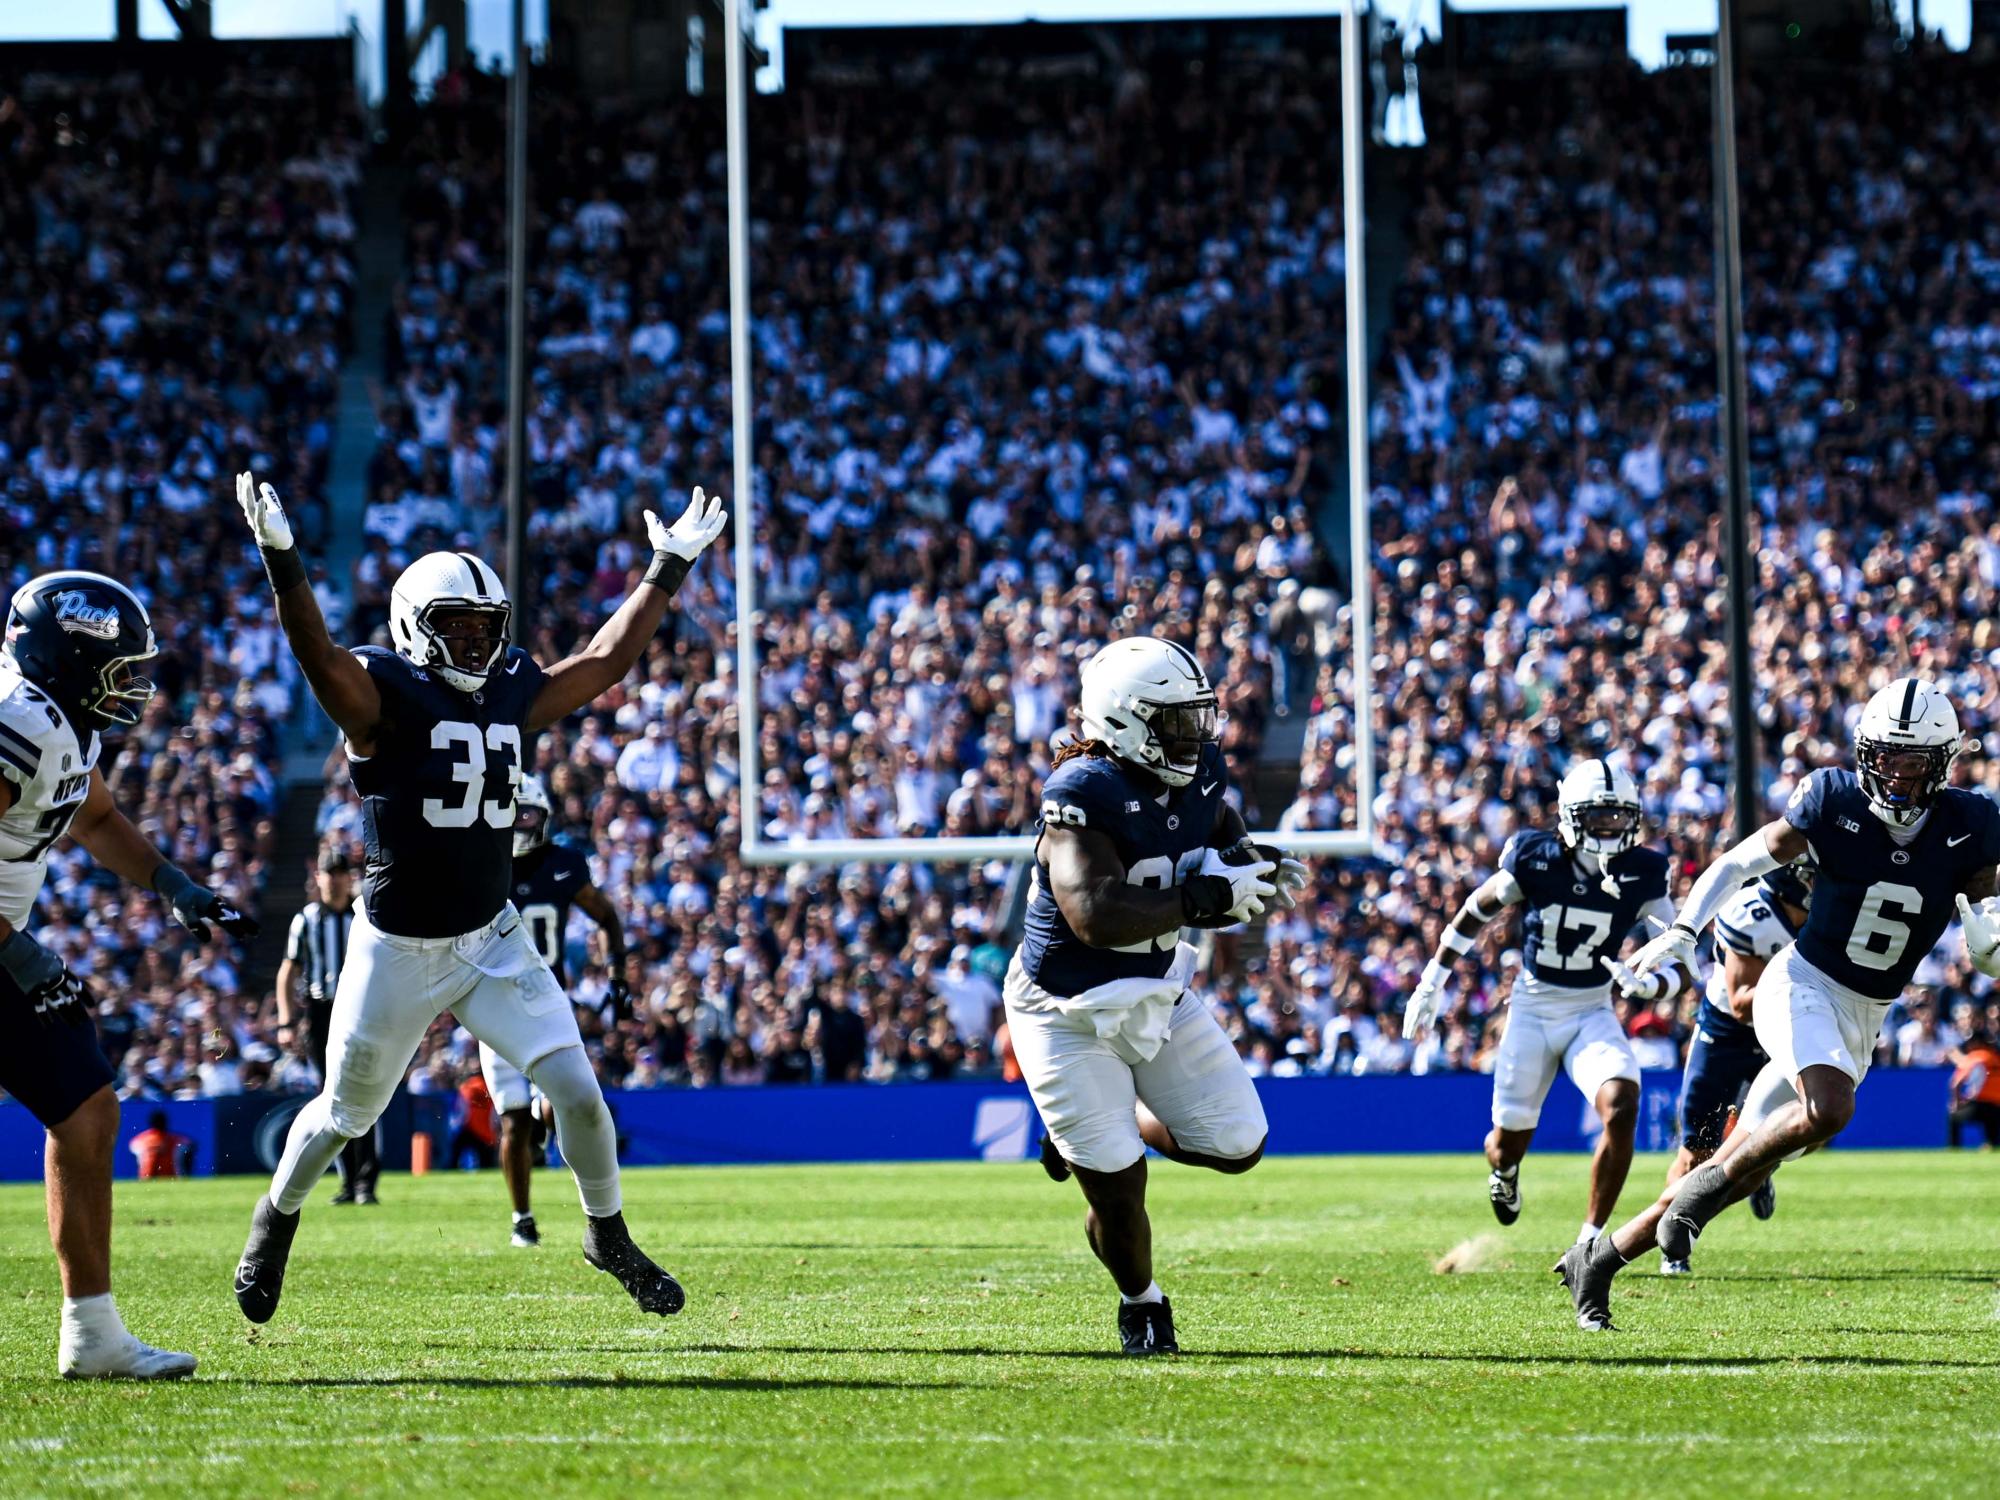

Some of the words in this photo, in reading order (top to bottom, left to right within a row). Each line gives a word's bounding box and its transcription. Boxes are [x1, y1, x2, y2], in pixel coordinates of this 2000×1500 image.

[53, 590, 120, 628] Pack
[422, 720, 522, 829] 33
[1536, 903, 1613, 971] 17
[1744, 899, 1771, 922] 18
[1846, 881, 1924, 971] 6
